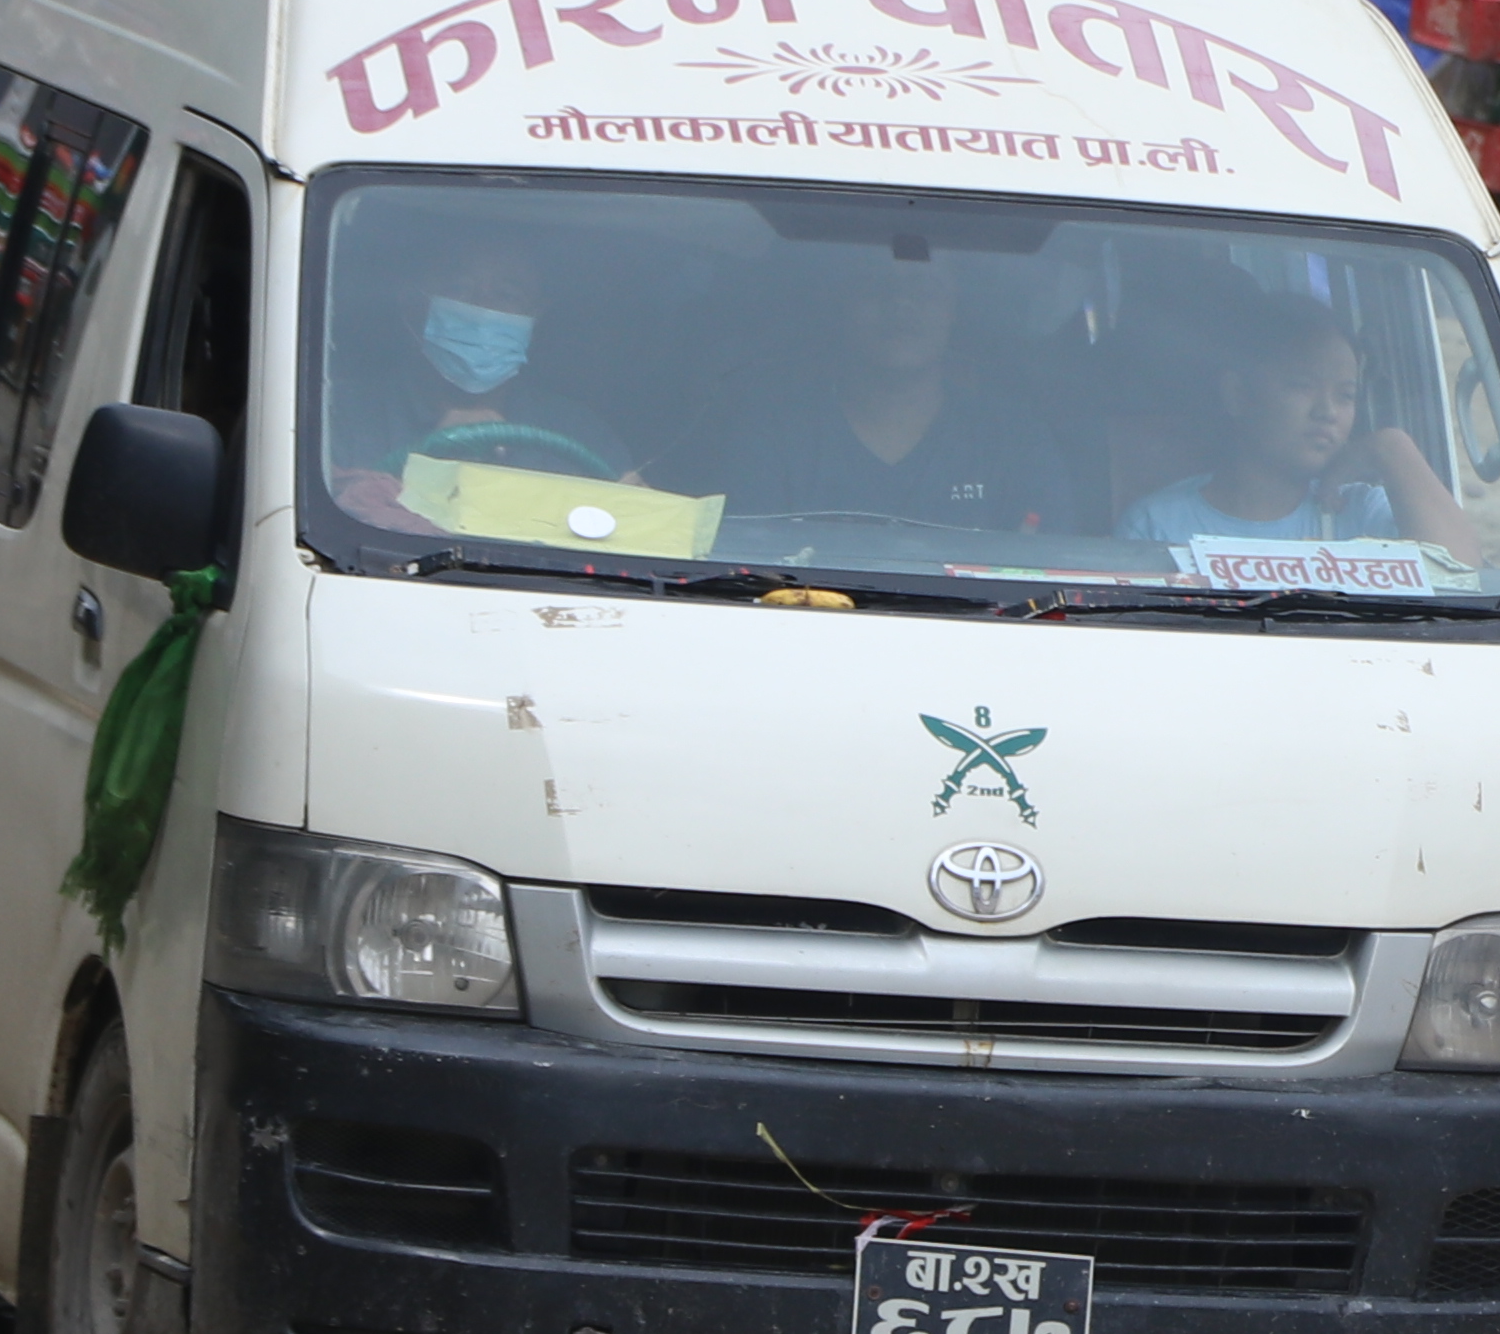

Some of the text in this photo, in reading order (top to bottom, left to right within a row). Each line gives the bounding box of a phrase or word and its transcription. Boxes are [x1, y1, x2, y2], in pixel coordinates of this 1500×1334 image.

[524, 105, 818, 147] मौलाकाली
[824, 120, 1061, 161] यातायात
[1206, 551, 1312, 589] बुटवल
[1311, 546, 1425, 590] भैरहवा
[974, 705, 992, 729] 8
[966, 784, 1005, 798] 2nd
